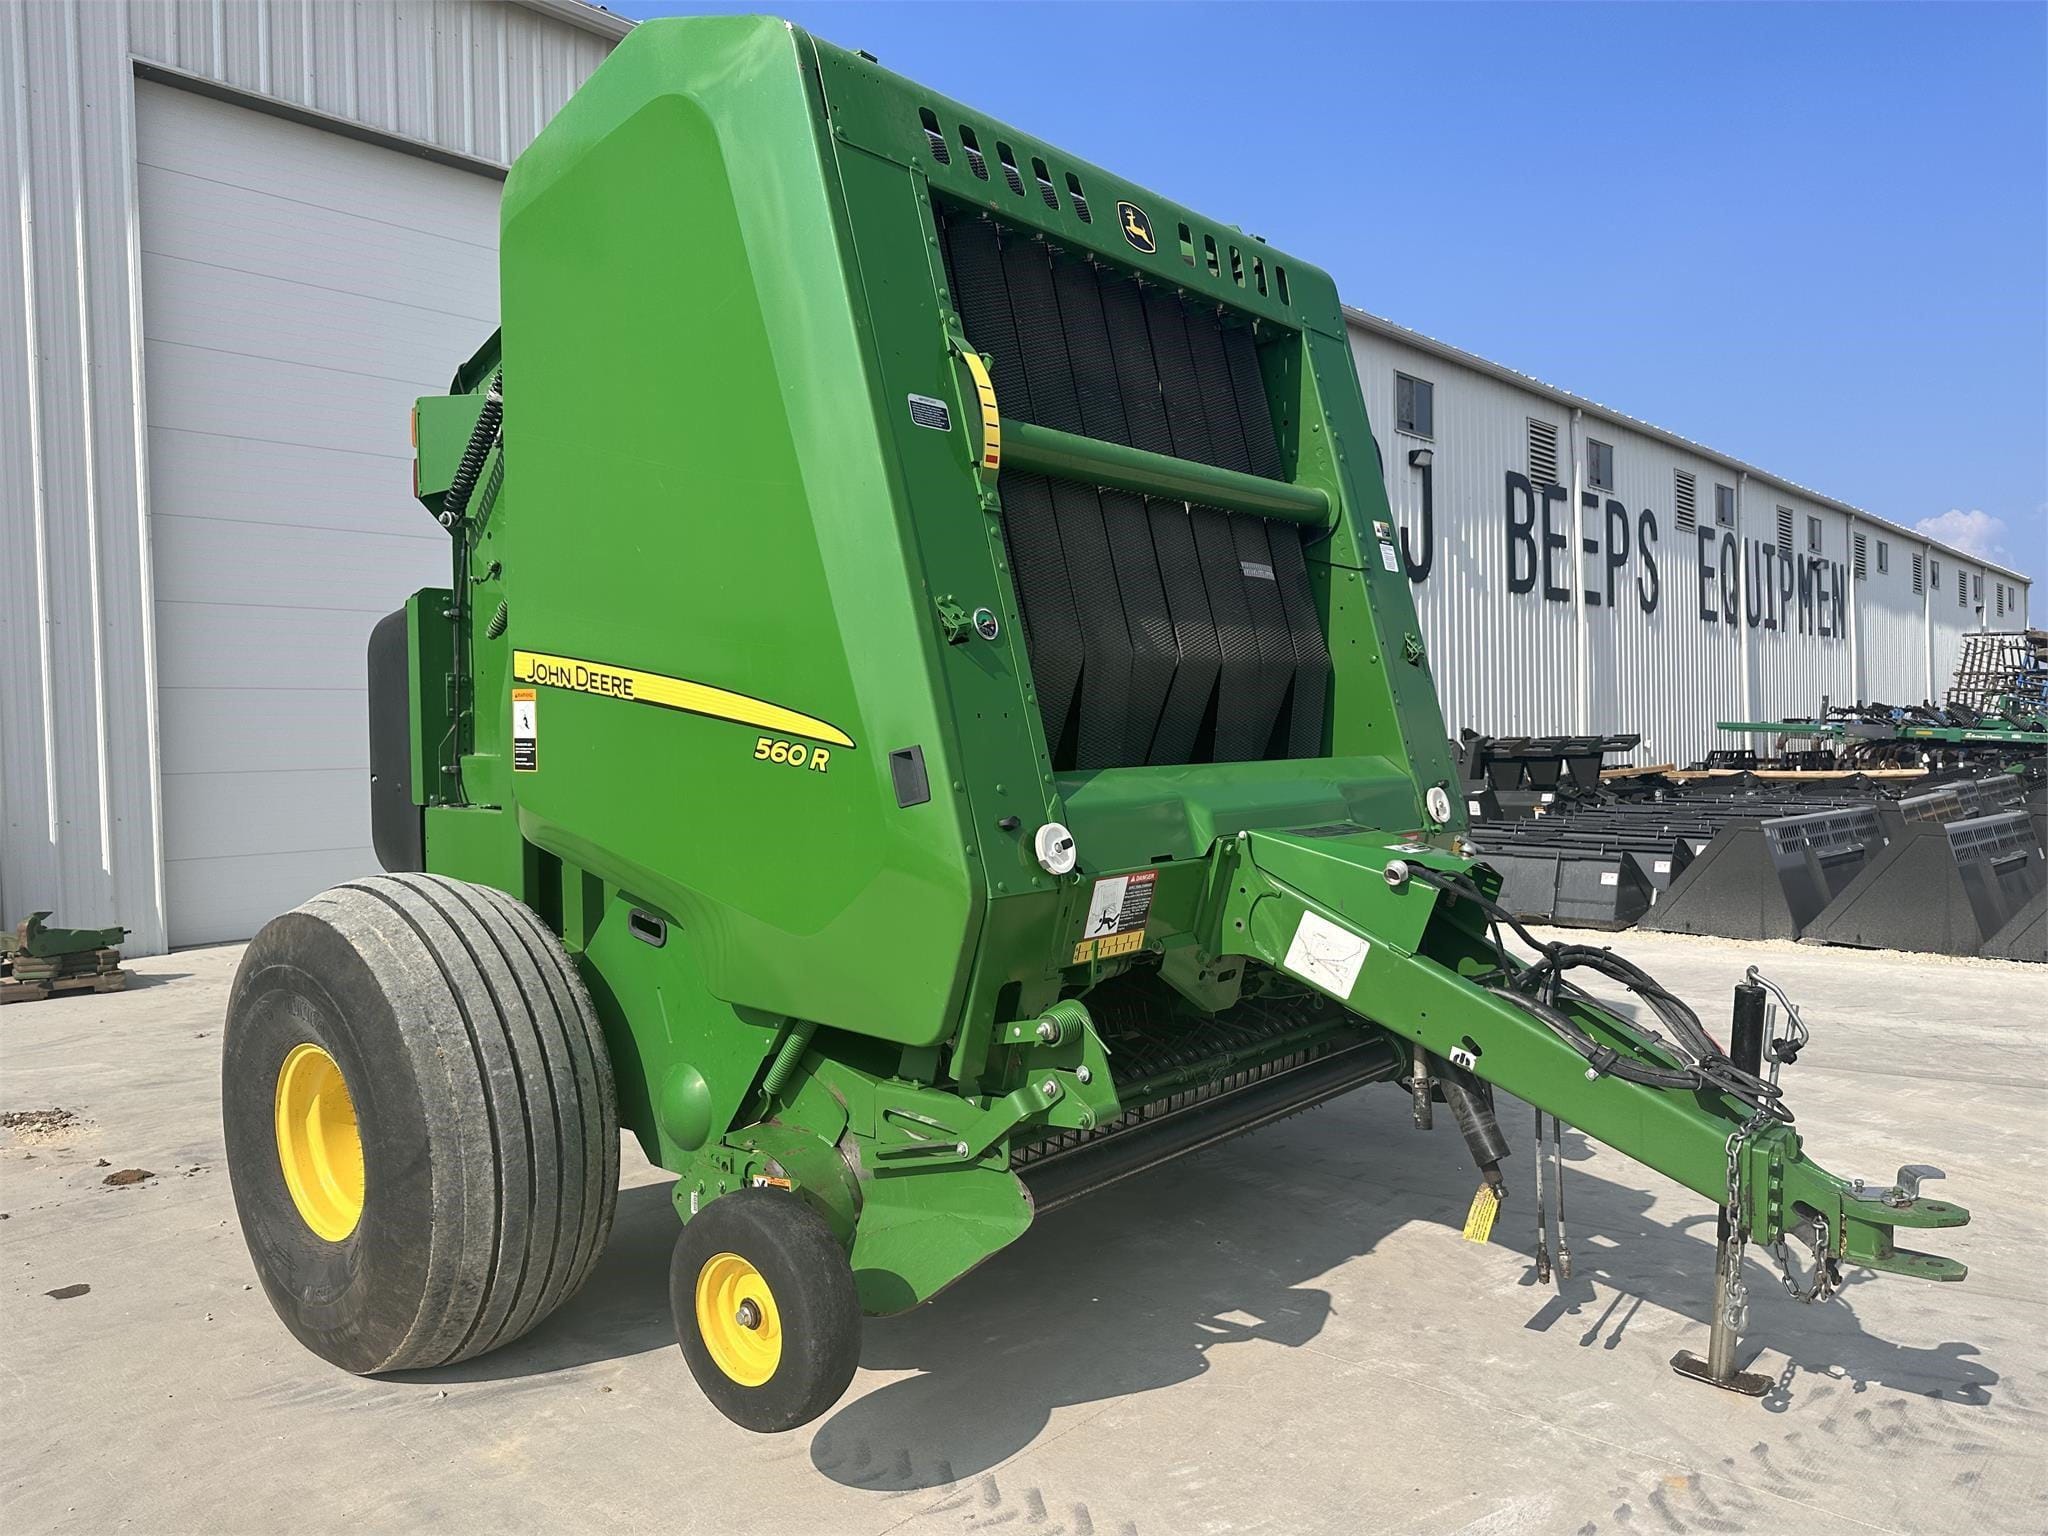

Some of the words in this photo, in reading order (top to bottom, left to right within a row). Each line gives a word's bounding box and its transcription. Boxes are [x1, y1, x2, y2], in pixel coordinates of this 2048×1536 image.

[1401, 454, 1432, 583] J
[1506, 470, 1659, 614] BEEPS
[1698, 525, 1858, 639] EQUIPMEN
[527, 659, 571, 685] JOHN
[575, 665, 634, 697] DEERE
[753, 736, 808, 767] 560
[808, 746, 831, 773] R
